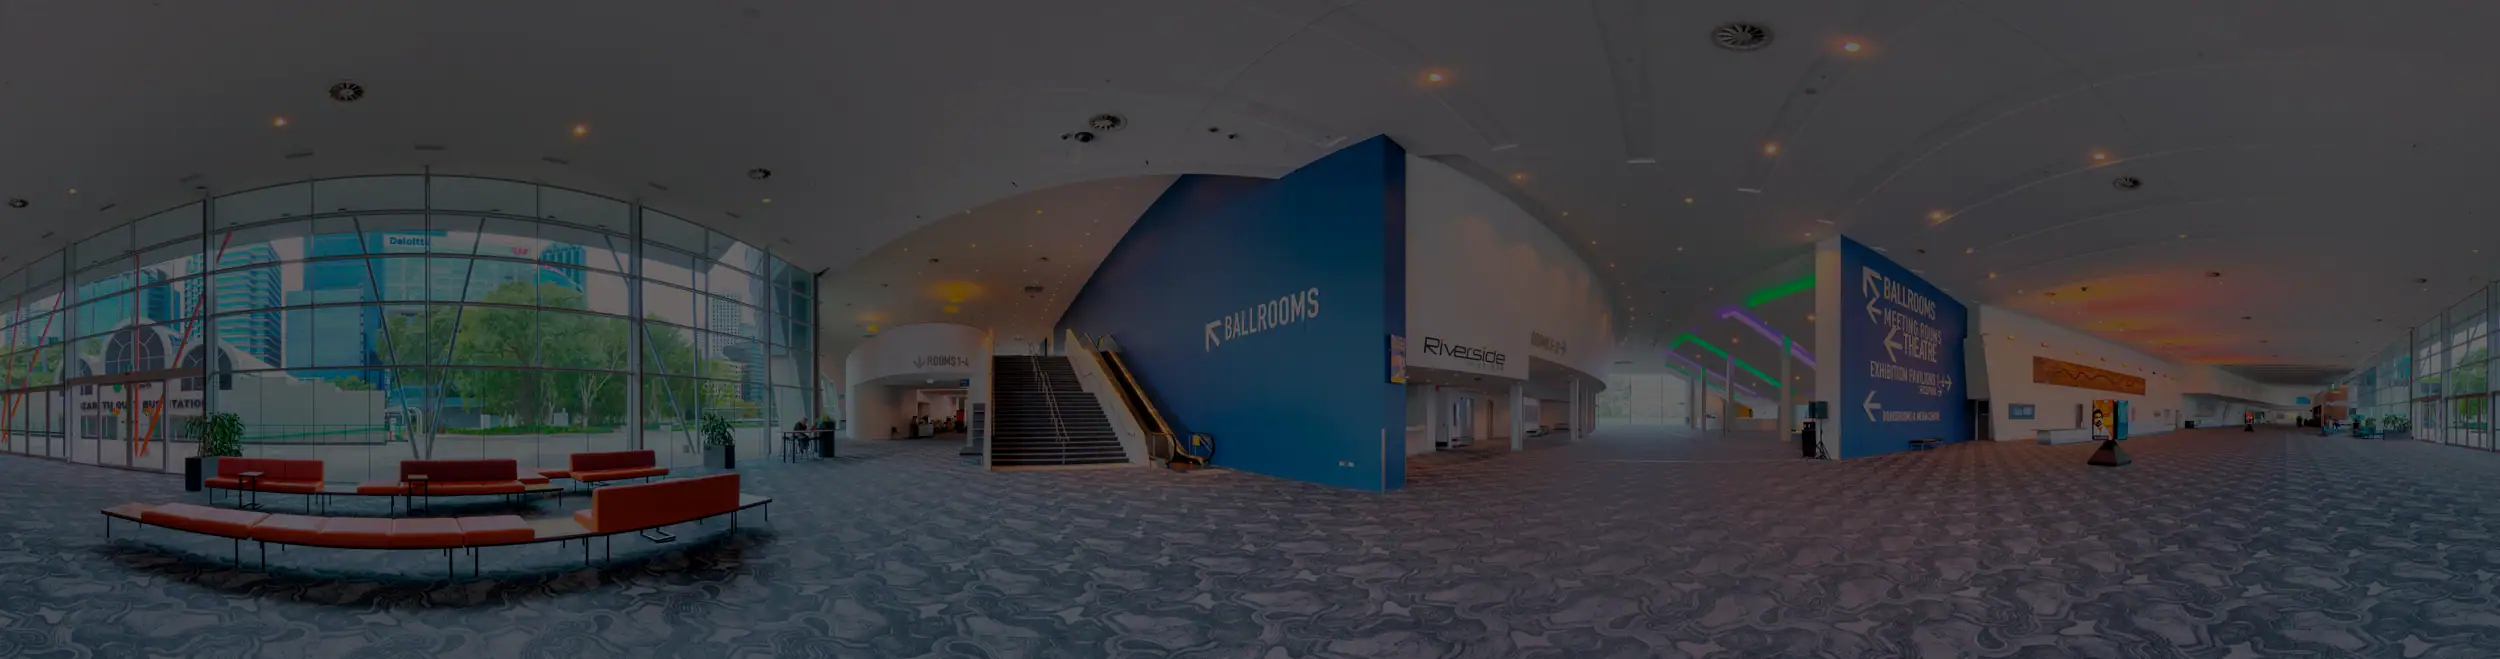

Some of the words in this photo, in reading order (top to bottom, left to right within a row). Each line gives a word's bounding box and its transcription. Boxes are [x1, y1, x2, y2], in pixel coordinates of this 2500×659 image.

[1225, 287, 1320, 341] BALLROOMS
[1884, 276, 1936, 321] BALLROOMS
[1884, 307, 1918, 336] MEETING
[1920, 322, 1942, 345] ROOMS
[927, 354, 956, 367] ROOMS
[1424, 336, 1506, 366] Riverside
[1903, 332, 1937, 363] THEATRE
[1870, 360, 1908, 383] EXHIBITION
